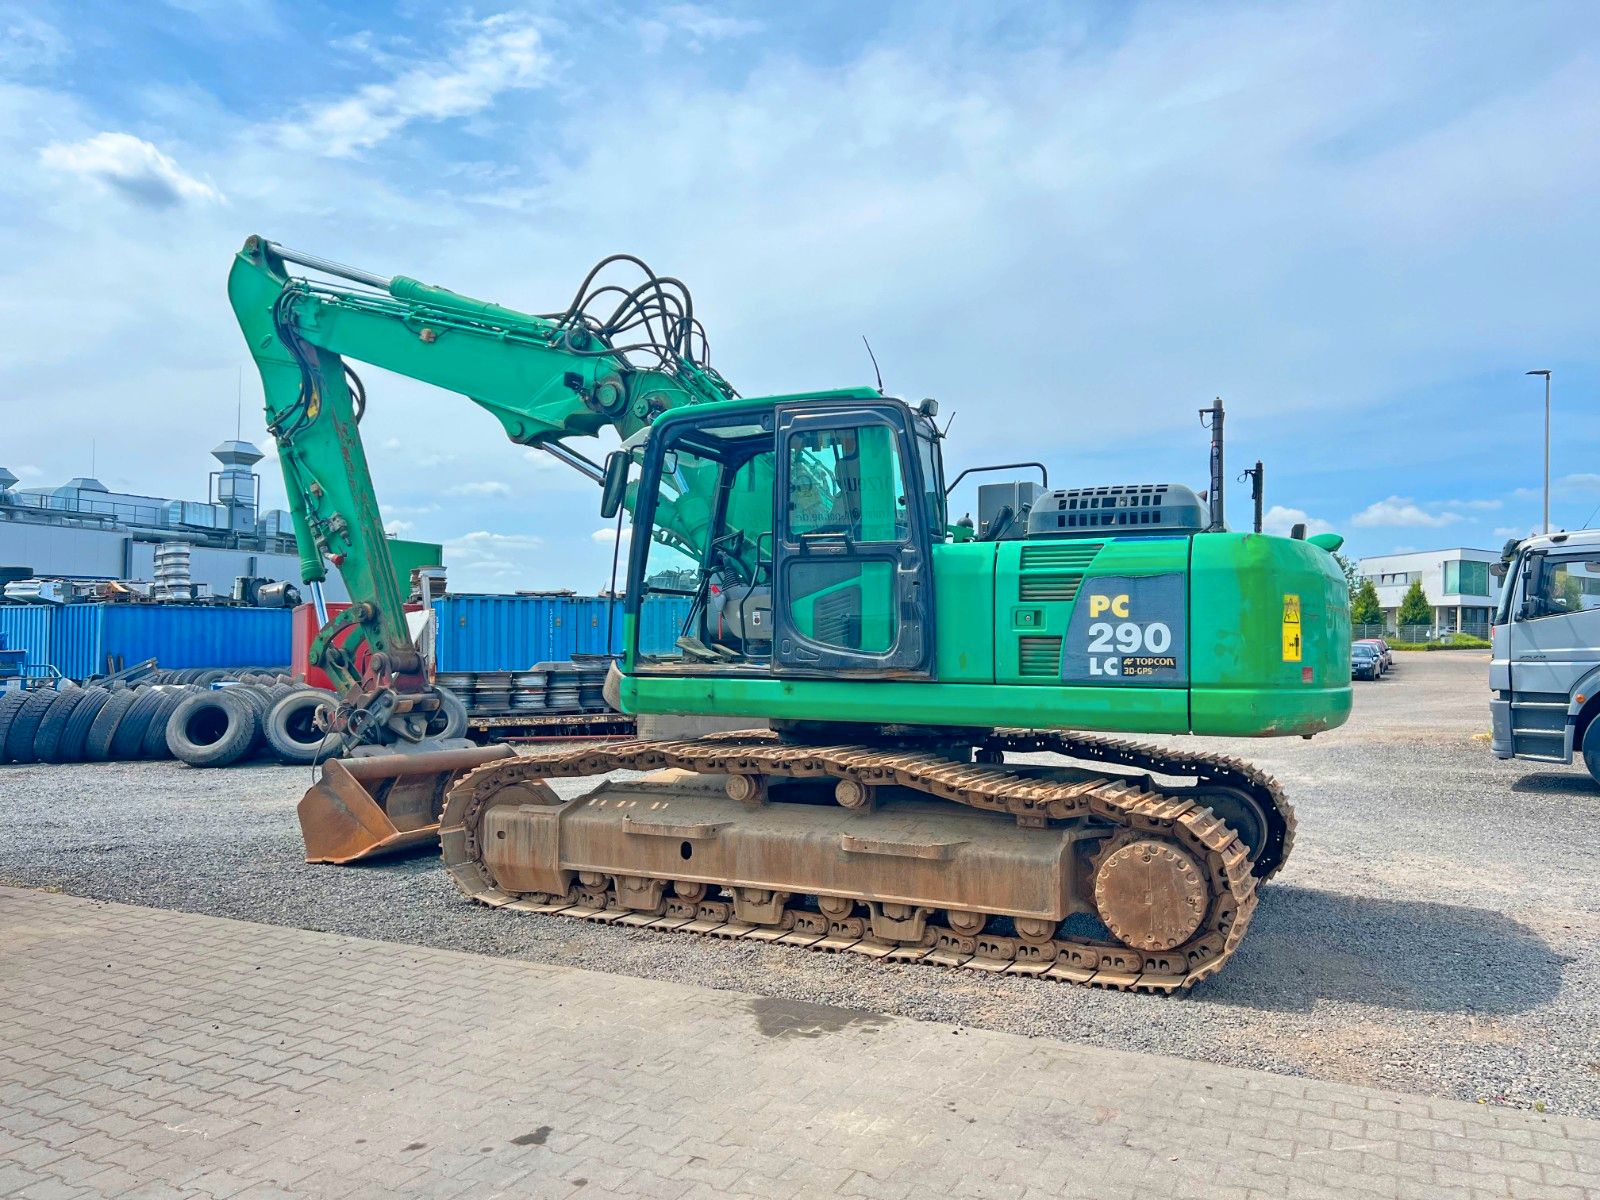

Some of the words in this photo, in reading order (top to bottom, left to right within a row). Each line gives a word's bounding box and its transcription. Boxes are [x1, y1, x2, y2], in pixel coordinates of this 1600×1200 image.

[1089, 594, 1130, 618] PC
[1087, 622, 1172, 654] 290
[1089, 656, 1119, 676] LC
[1123, 667, 1153, 675] 3D-GPS
[1135, 657, 1175, 666] TOPCON
